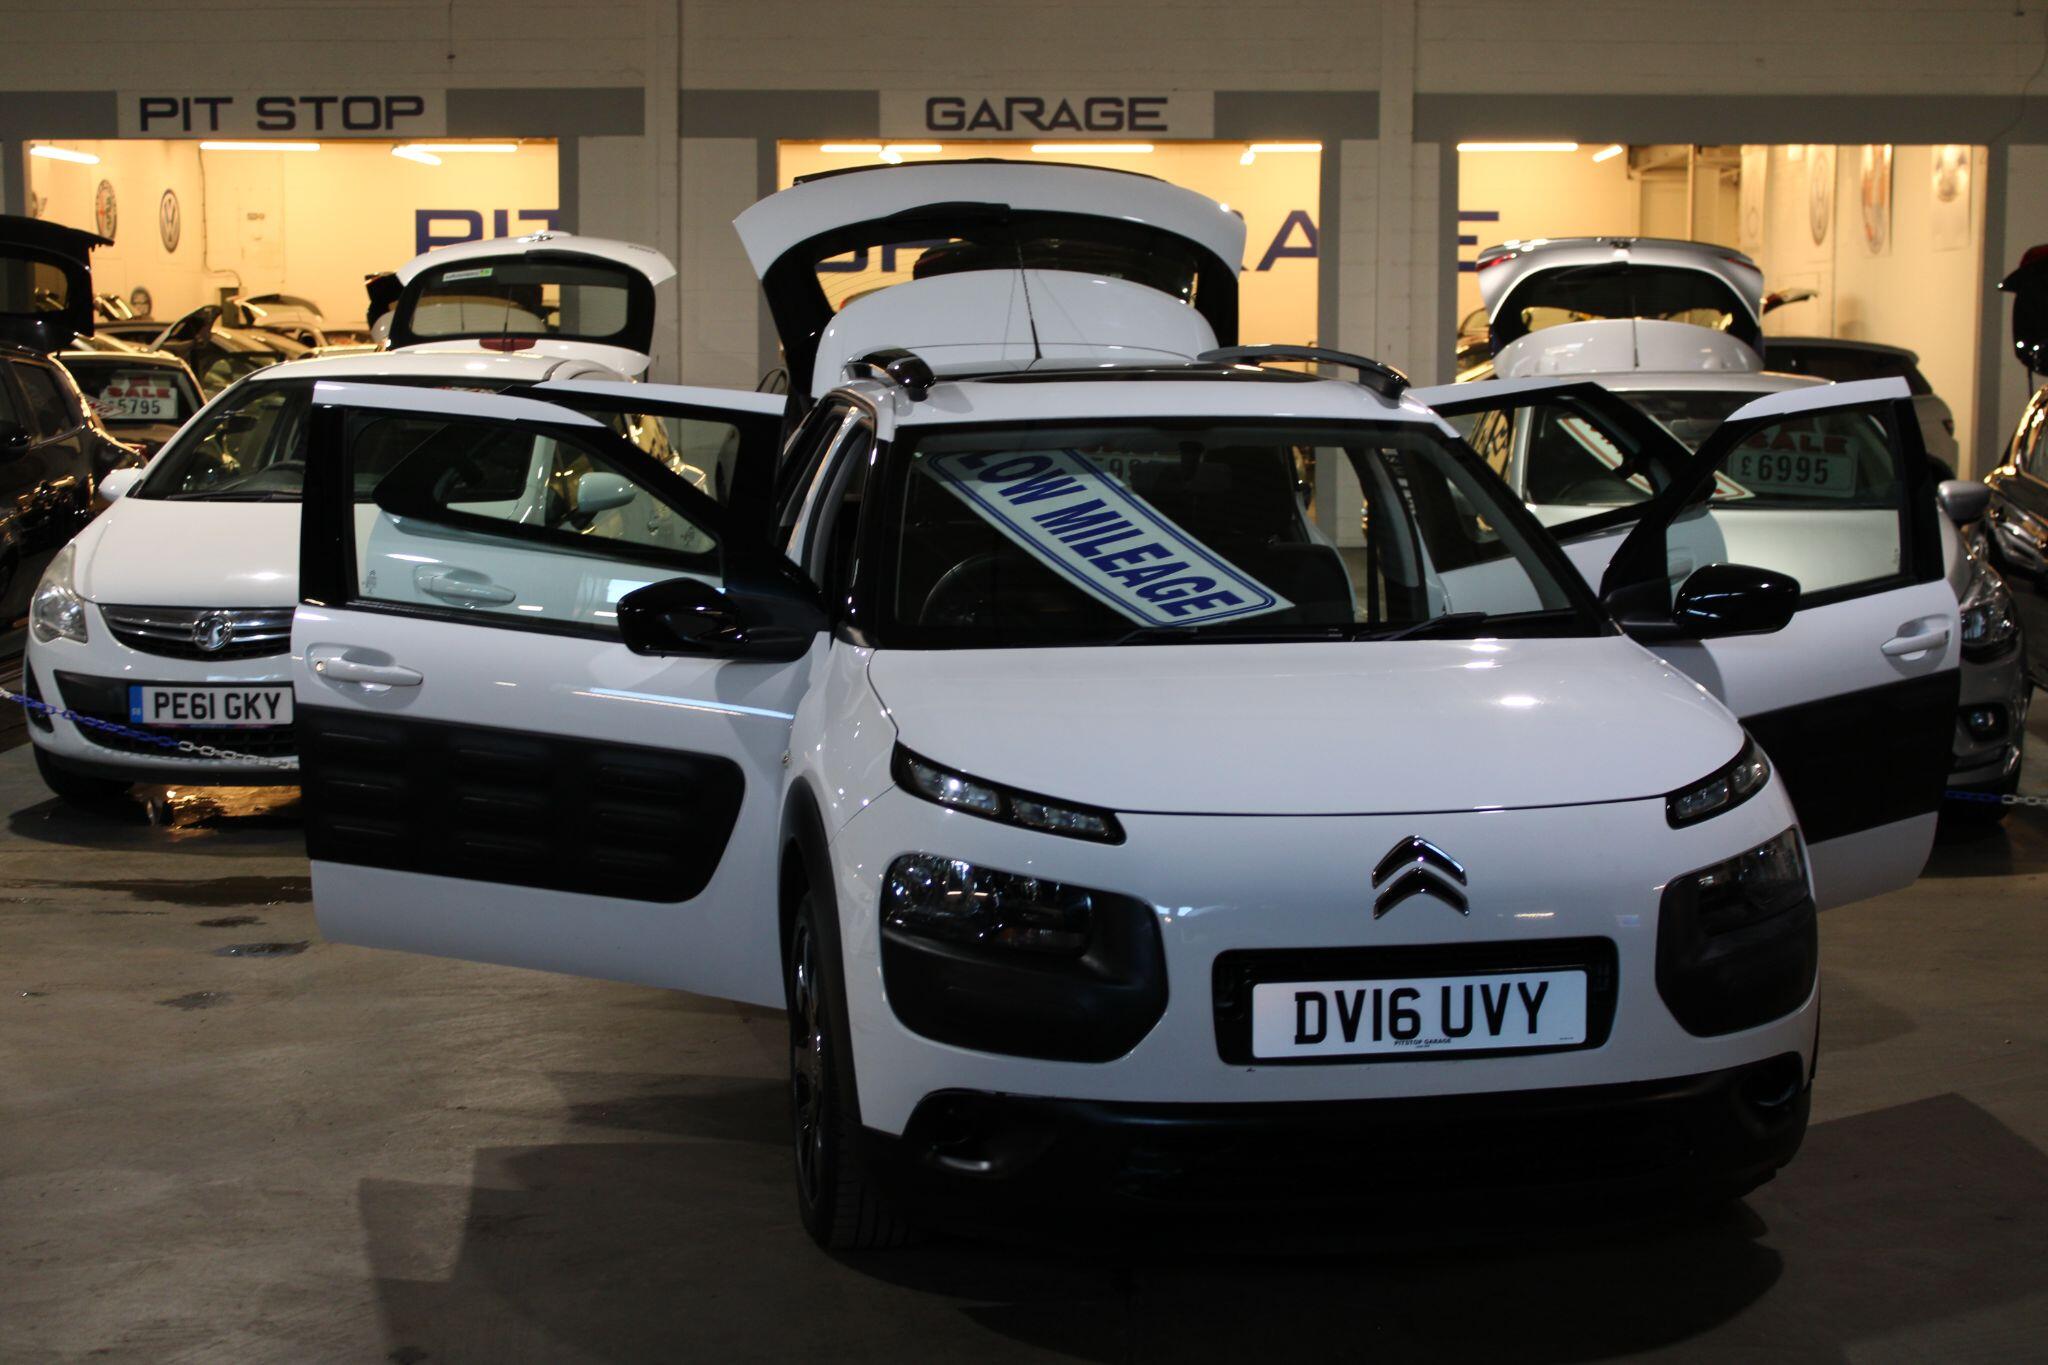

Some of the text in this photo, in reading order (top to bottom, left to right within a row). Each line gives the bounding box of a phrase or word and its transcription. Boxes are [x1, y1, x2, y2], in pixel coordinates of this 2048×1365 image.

[140, 96, 425, 132] PIT STOP
[925, 97, 1168, 132] GARAGE
[107, 387, 171, 399] SALE
[108, 399, 161, 415] 5795
[1740, 454, 1829, 485] £6995
[1031, 498, 1246, 617] MILEAGE
[154, 692, 281, 720] PE61 GKY
[1293, 980, 1549, 1045] DV16 UVY
